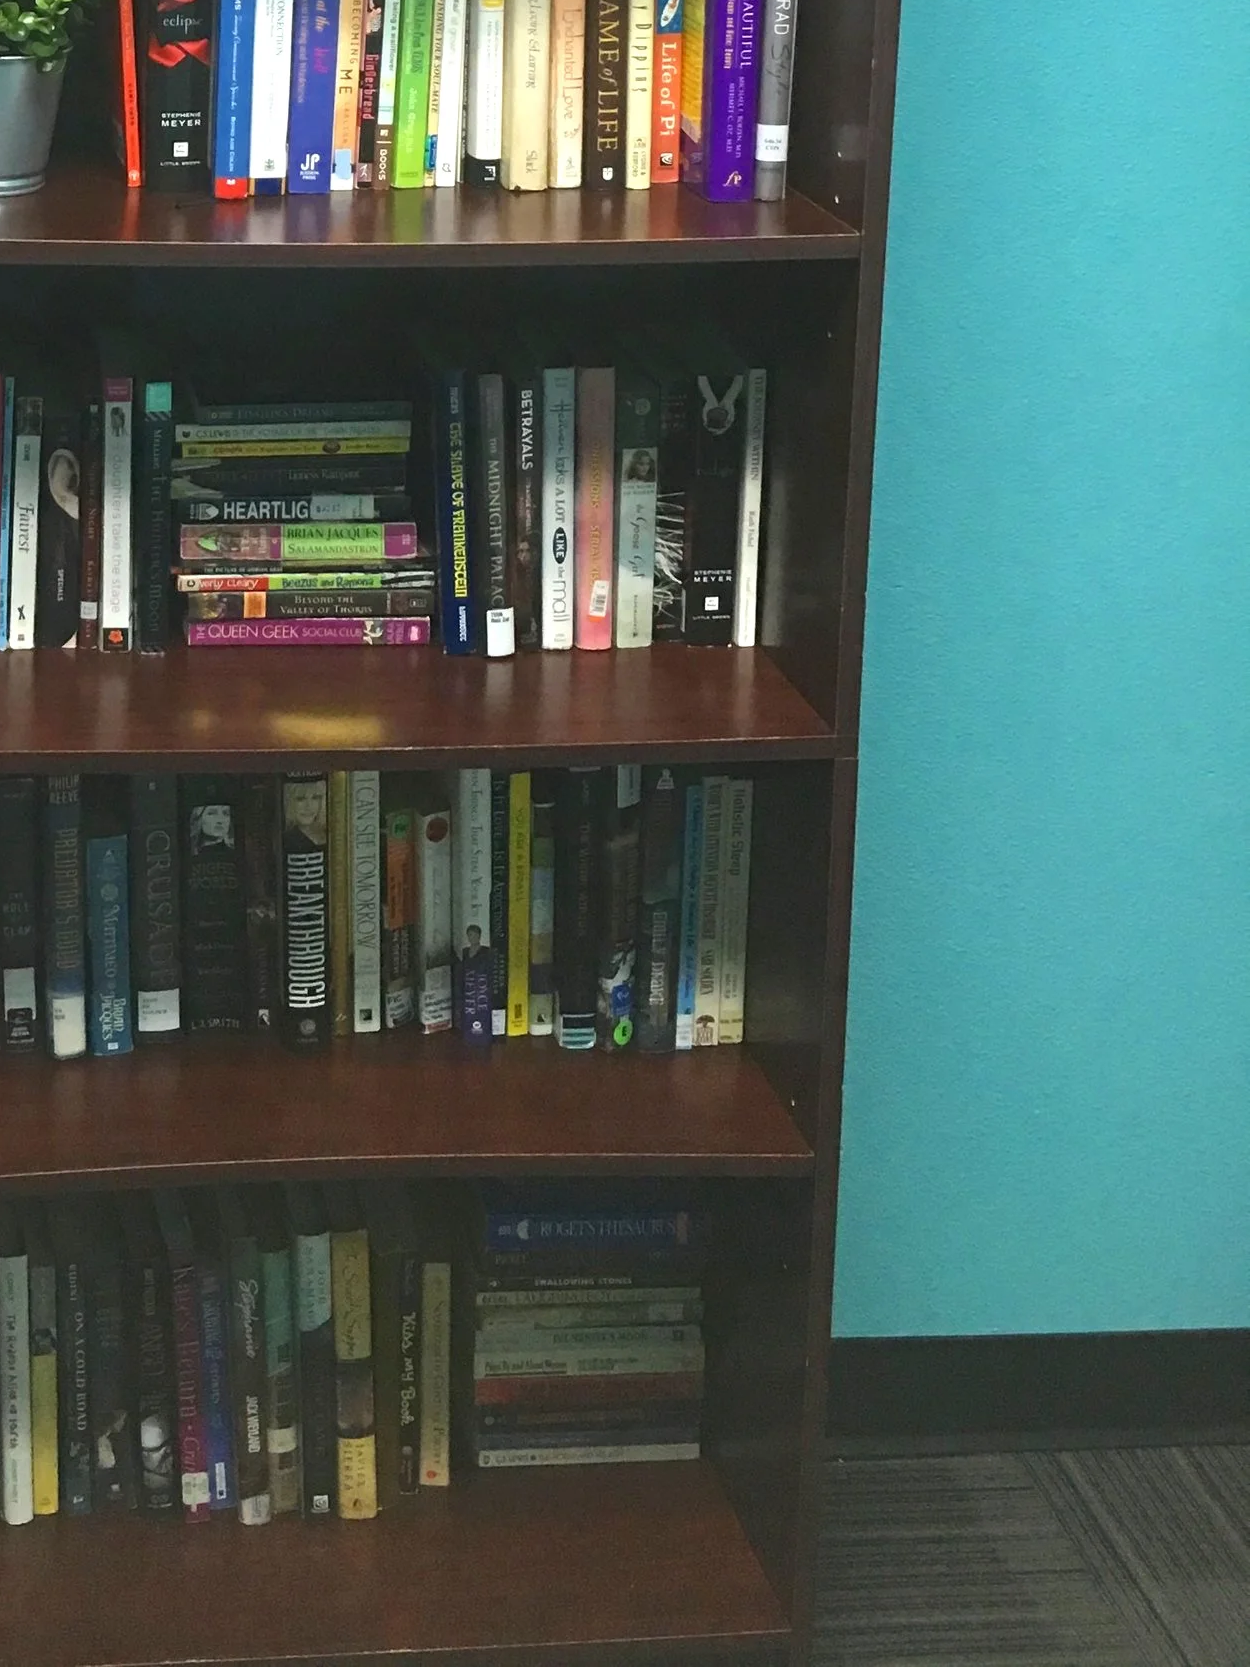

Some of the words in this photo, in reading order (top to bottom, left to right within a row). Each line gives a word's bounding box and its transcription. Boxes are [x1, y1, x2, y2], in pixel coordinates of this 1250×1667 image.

[350, 0, 361, 64] BECOMING
[435, 37, 443, 59] YOUR
[598, 68, 619, 85] of
[632, 23, 651, 93] Dipping
[661, 42, 677, 83] Life
[338, 69, 353, 94] ME
[431, 63, 440, 113] SOUL-MATE
[660, 88, 674, 109] of
[597, 91, 618, 152] LIFE
[659, 116, 674, 136] Pi
[521, 390, 533, 470] BETRAYALS
[452, 492, 465, 507] OF
[488, 460, 502, 548] MIDNIGHT
[17, 503, 34, 553] Fairest
[287, 528, 324, 538] BRIAN
[327, 528, 378, 538] JACQUES
[555, 532, 566, 558] LIKE
[208, 626, 259, 638] QUEEN
[262, 626, 298, 638] GEEK
[302, 627, 335, 637] SOCIAL
[336, 628, 362, 637] CLUB
[356, 787, 374, 820] CAN
[358, 826, 374, 849] SEE
[357, 855, 376, 948] TOMORROW
[288, 852, 326, 1008] BREAKTHROUGH
[402, 1311, 415, 1353] Kiss
[401, 1387, 416, 1426] Book
